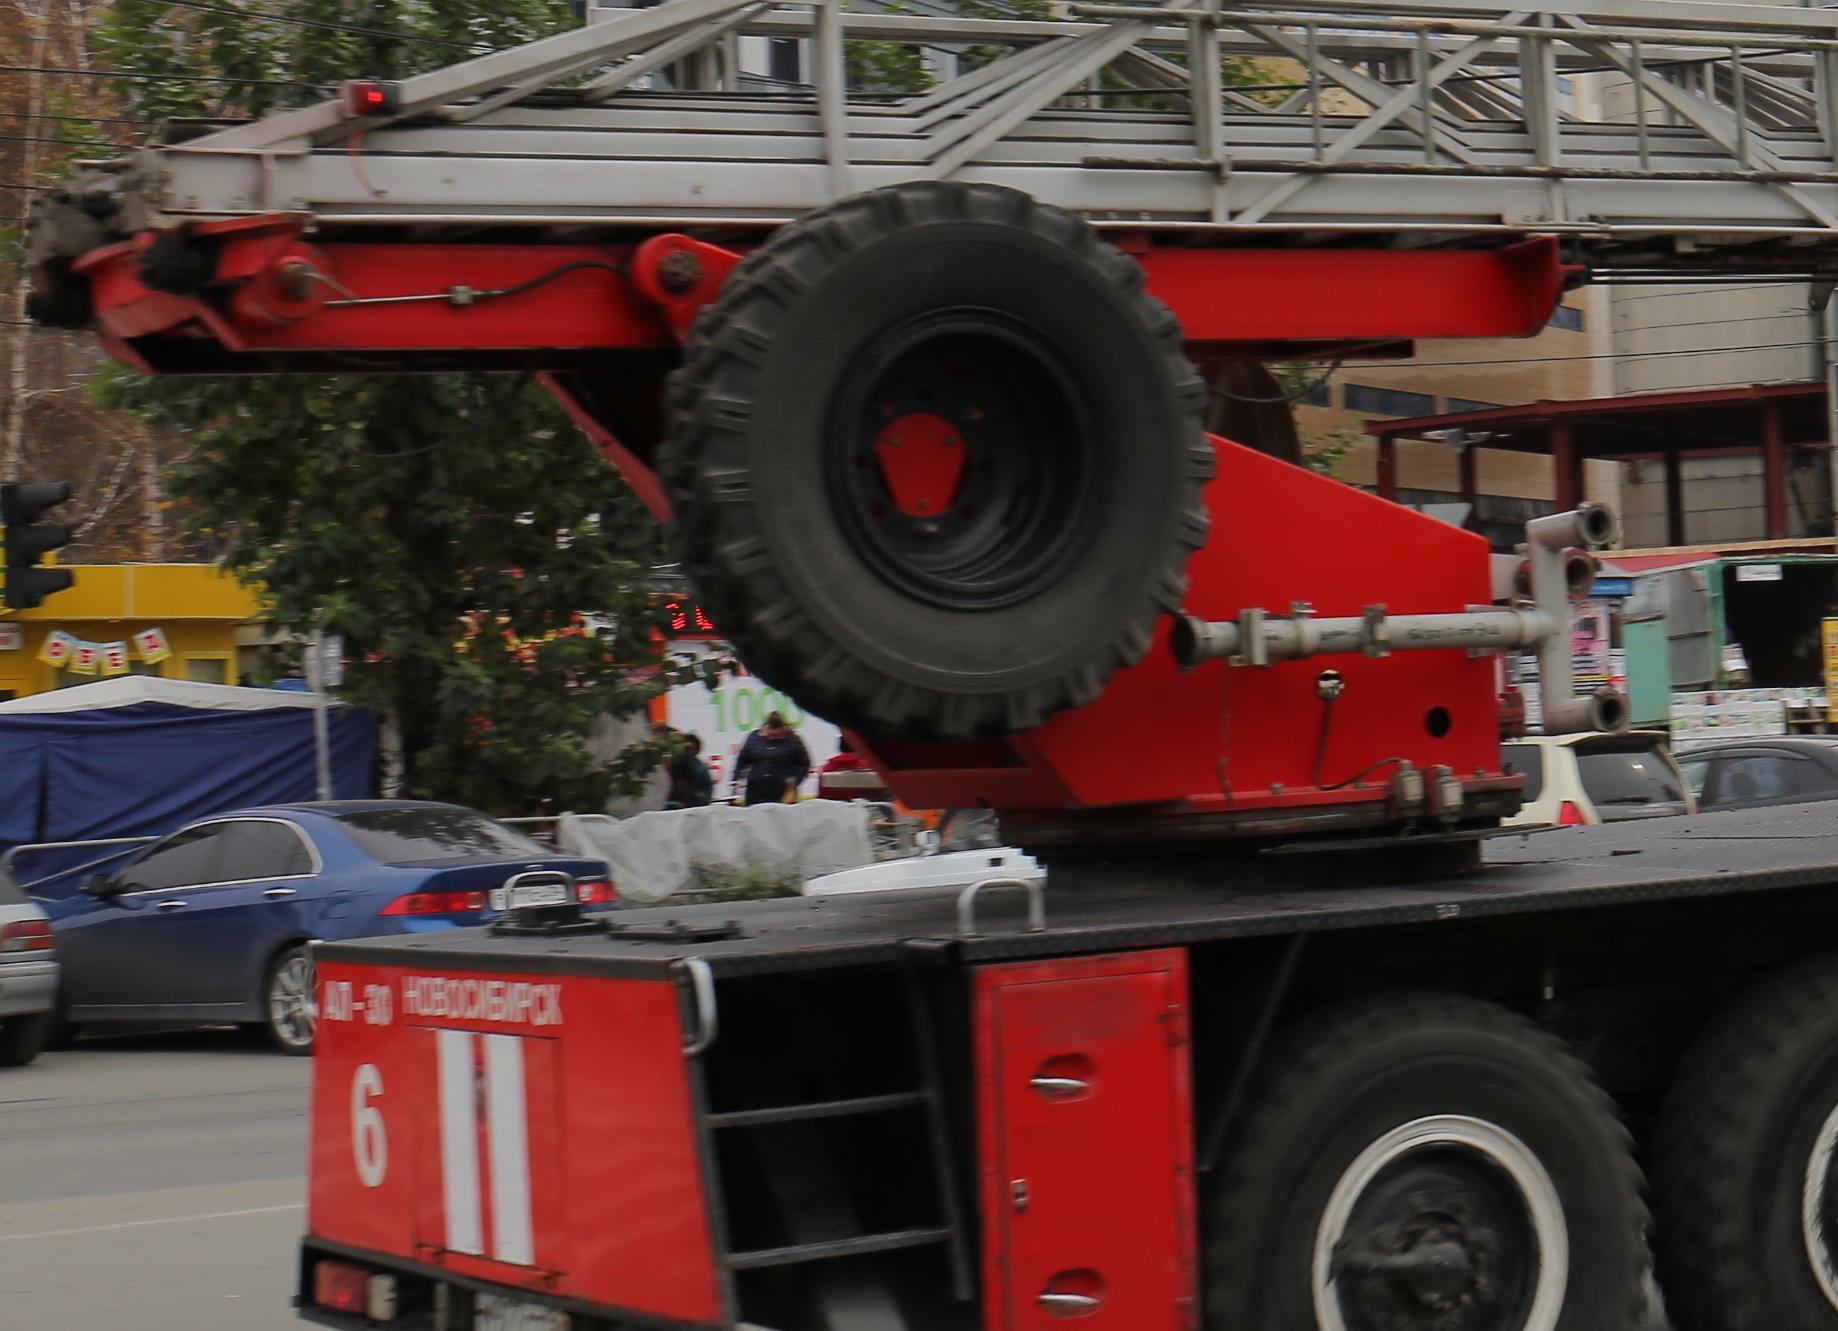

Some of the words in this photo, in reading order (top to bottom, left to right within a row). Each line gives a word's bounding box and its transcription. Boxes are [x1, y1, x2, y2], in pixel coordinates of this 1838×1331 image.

[323, 980, 394, 1026] АЛ-30
[402, 975, 564, 1026] НОВОСИБИРСК
[352, 1063, 388, 1188] 6
